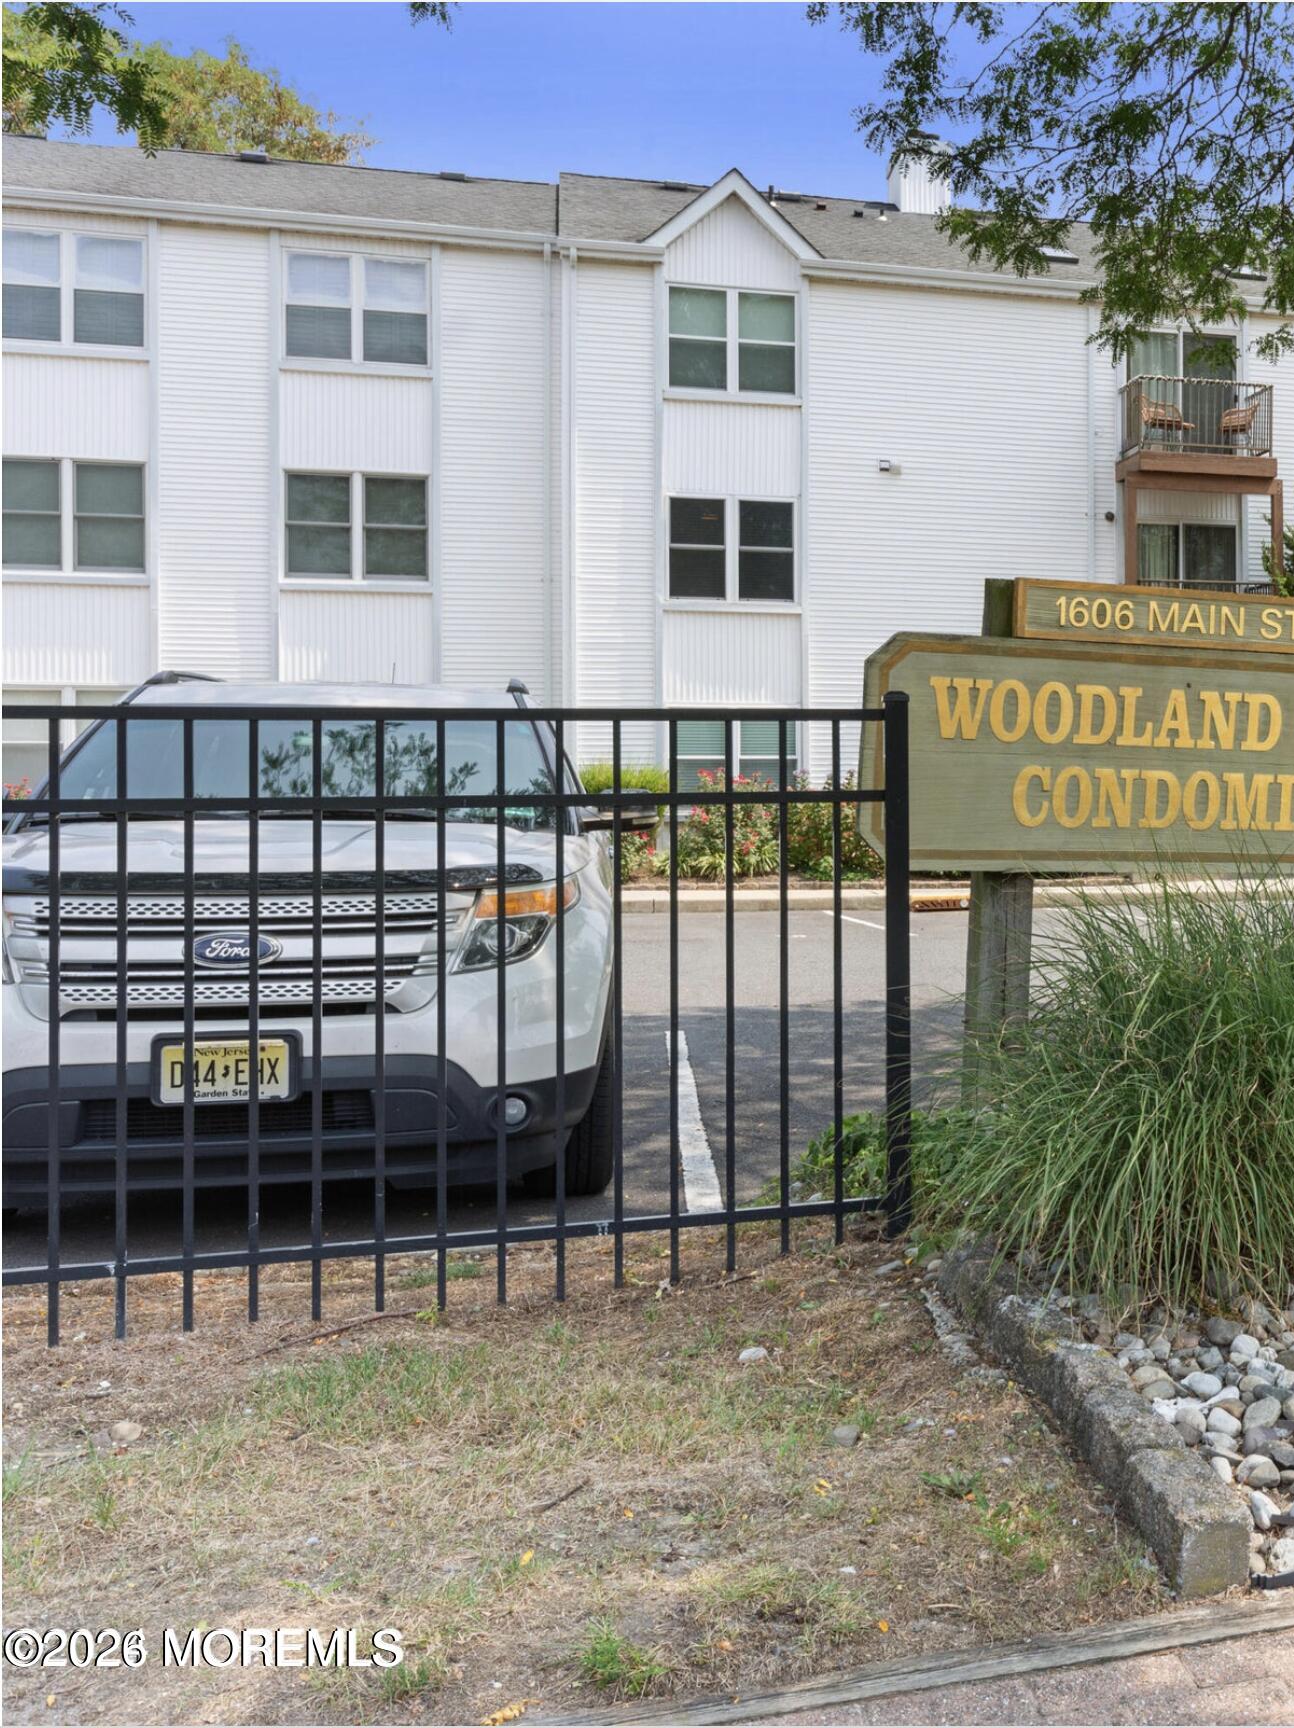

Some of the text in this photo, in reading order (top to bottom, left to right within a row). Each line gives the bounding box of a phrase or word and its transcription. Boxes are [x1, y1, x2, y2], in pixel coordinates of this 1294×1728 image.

[1056, 596, 1135, 630] 1606
[1148, 600, 1246, 637] MAIN
[929, 676, 1283, 751] WOODLAND
[194, 1046, 249, 1057] New Jerse
[193, 1087, 249, 1098] Garden Sta
